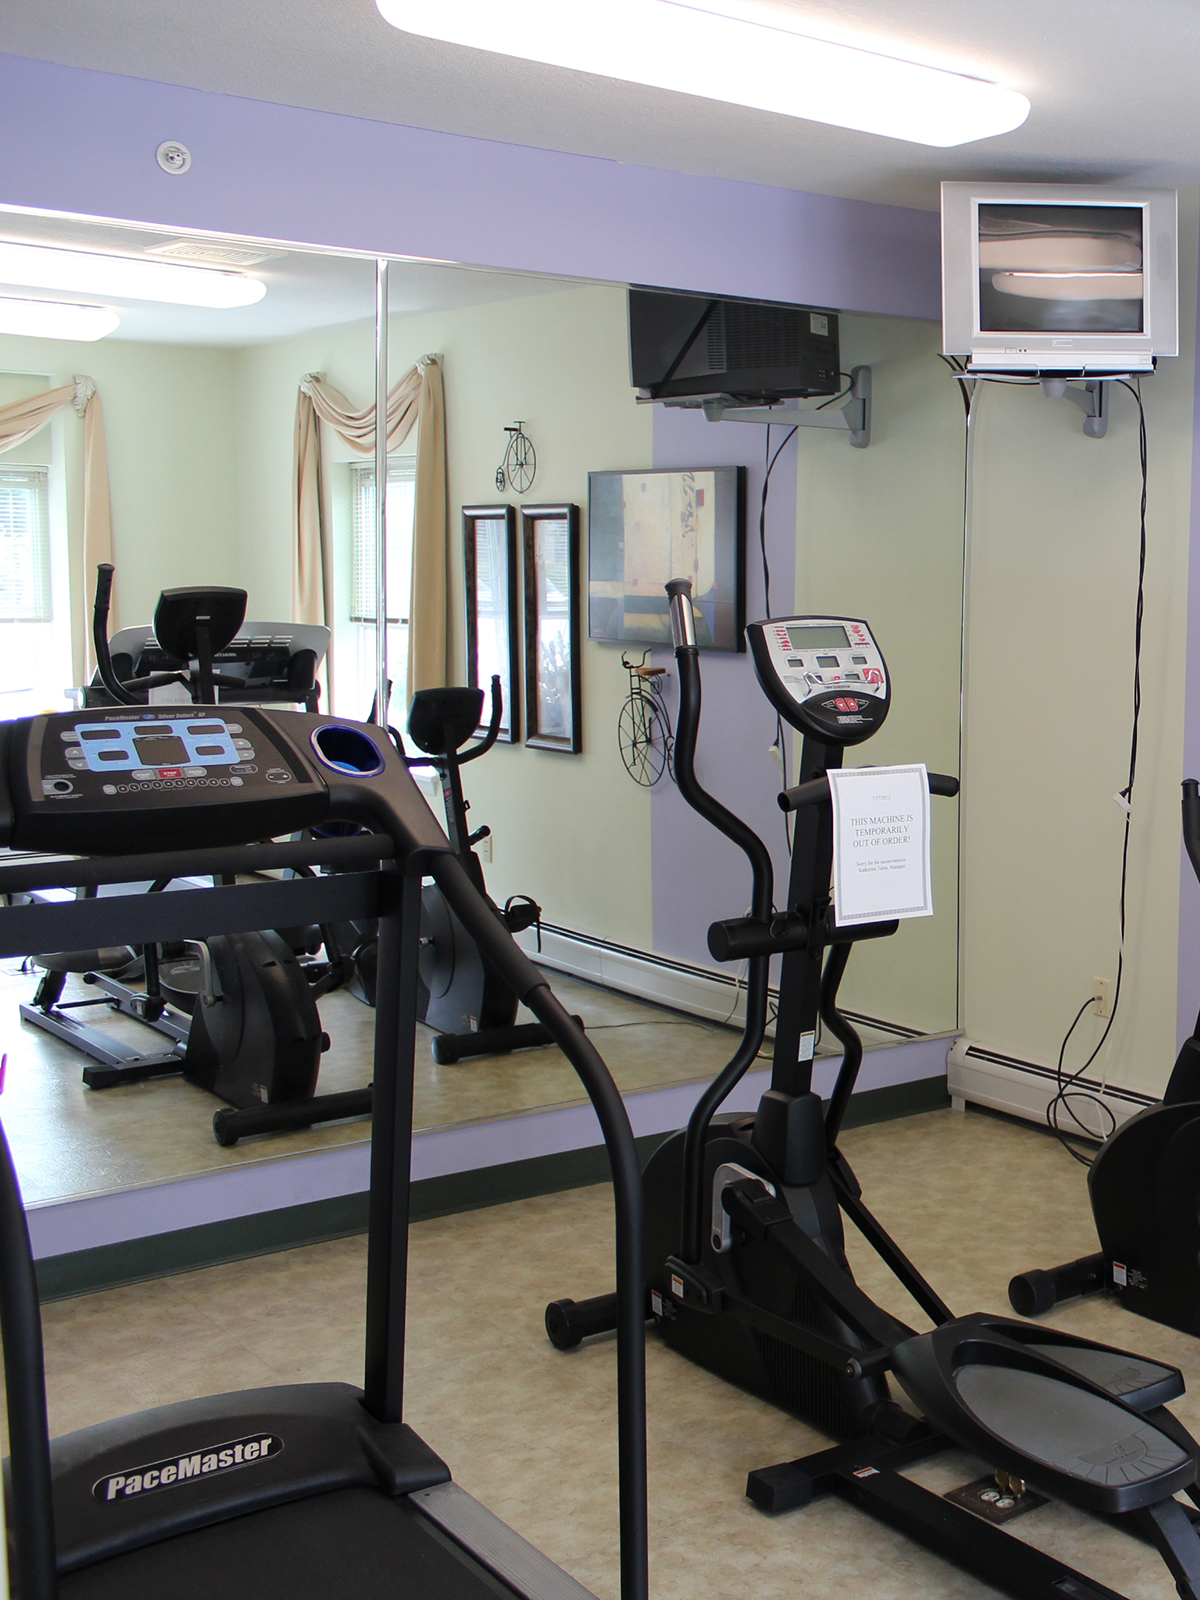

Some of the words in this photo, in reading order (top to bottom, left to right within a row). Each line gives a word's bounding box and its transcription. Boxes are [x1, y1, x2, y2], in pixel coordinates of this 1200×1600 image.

[850, 818, 868, 826] THIS
[869, 815, 905, 825] MACHINE
[906, 814, 914, 822] IS
[855, 825, 909, 837] TEMPORARILY
[852, 839, 870, 848] OUT
[870, 838, 881, 847] OF
[882, 836, 911, 845] ORDER!
[107, 1437, 272, 1500] PaceMaster
